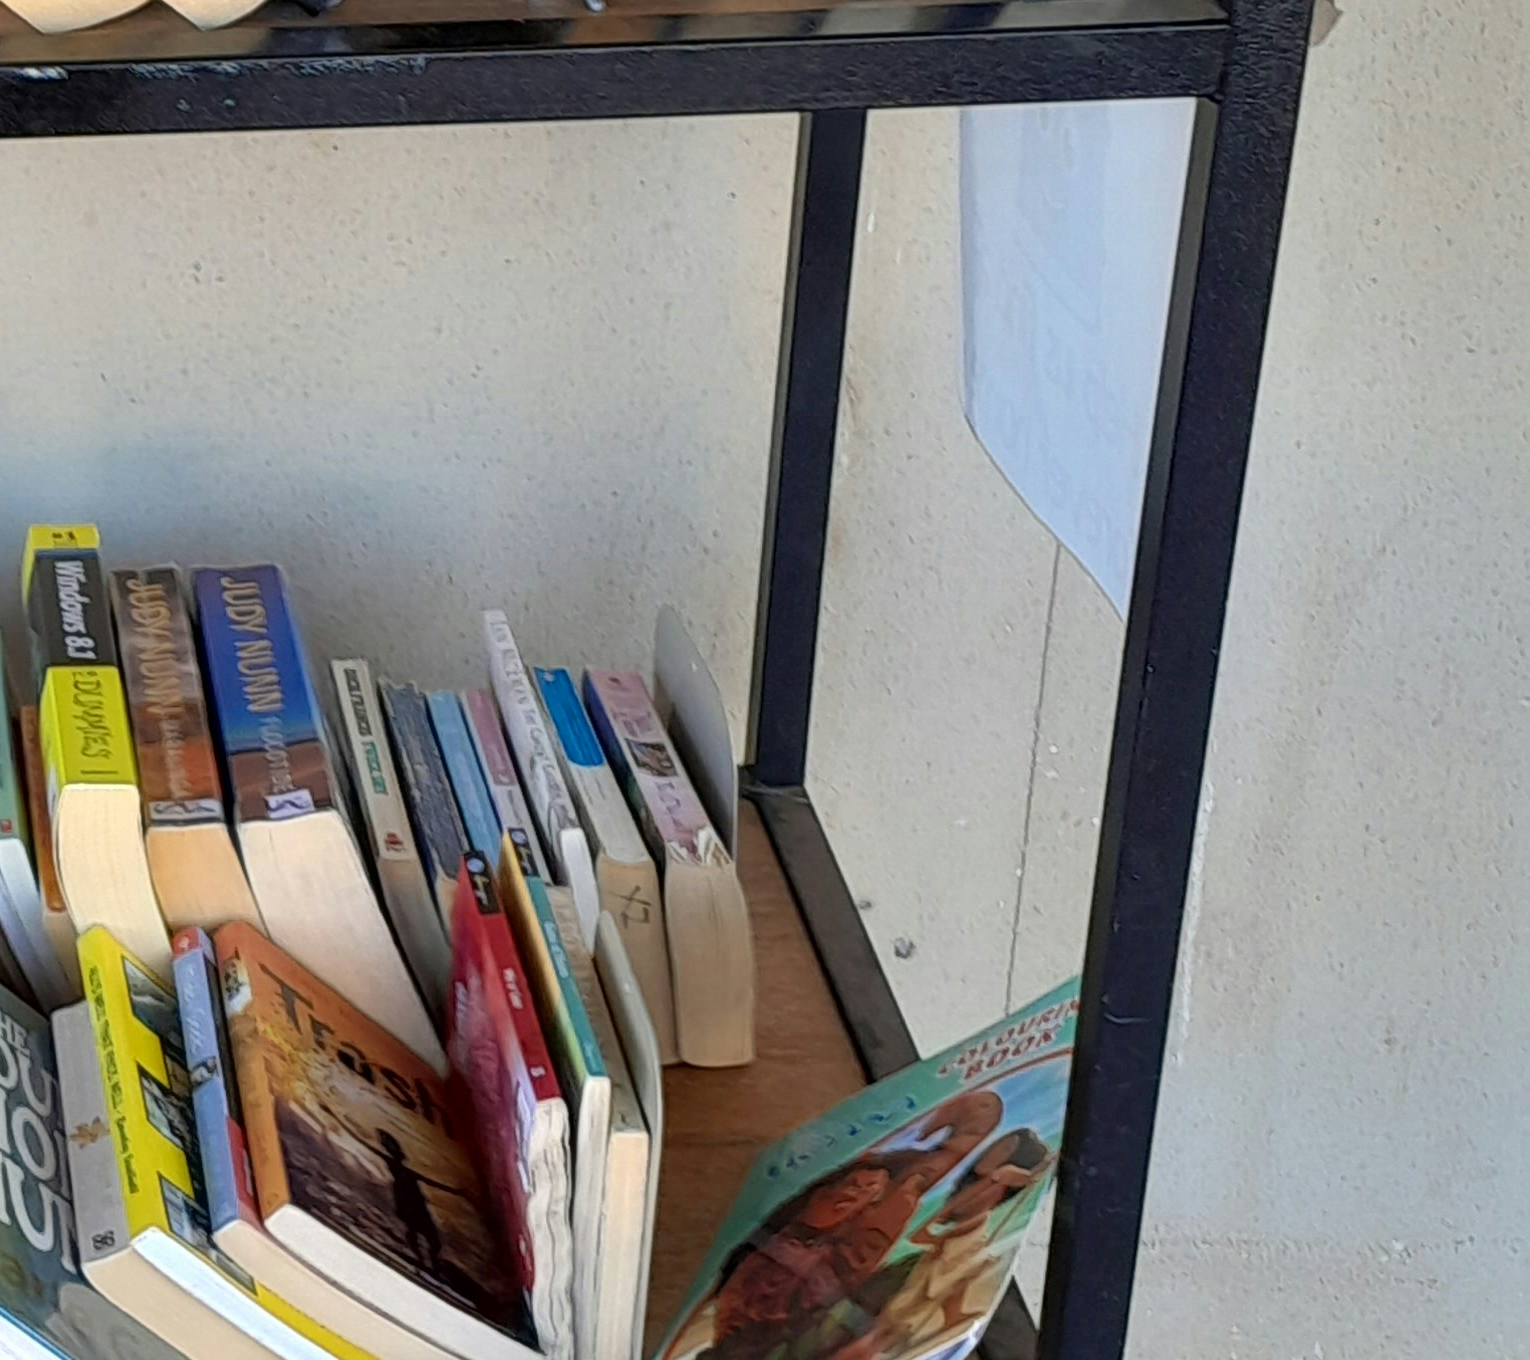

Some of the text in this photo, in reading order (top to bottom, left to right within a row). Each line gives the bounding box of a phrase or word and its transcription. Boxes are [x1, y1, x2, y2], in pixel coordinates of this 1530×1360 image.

[53, 559, 98, 661] Windows 8.1
[125, 576, 185, 715] JUDY NUNN
[220, 575, 285, 715] JUDY NUNN
